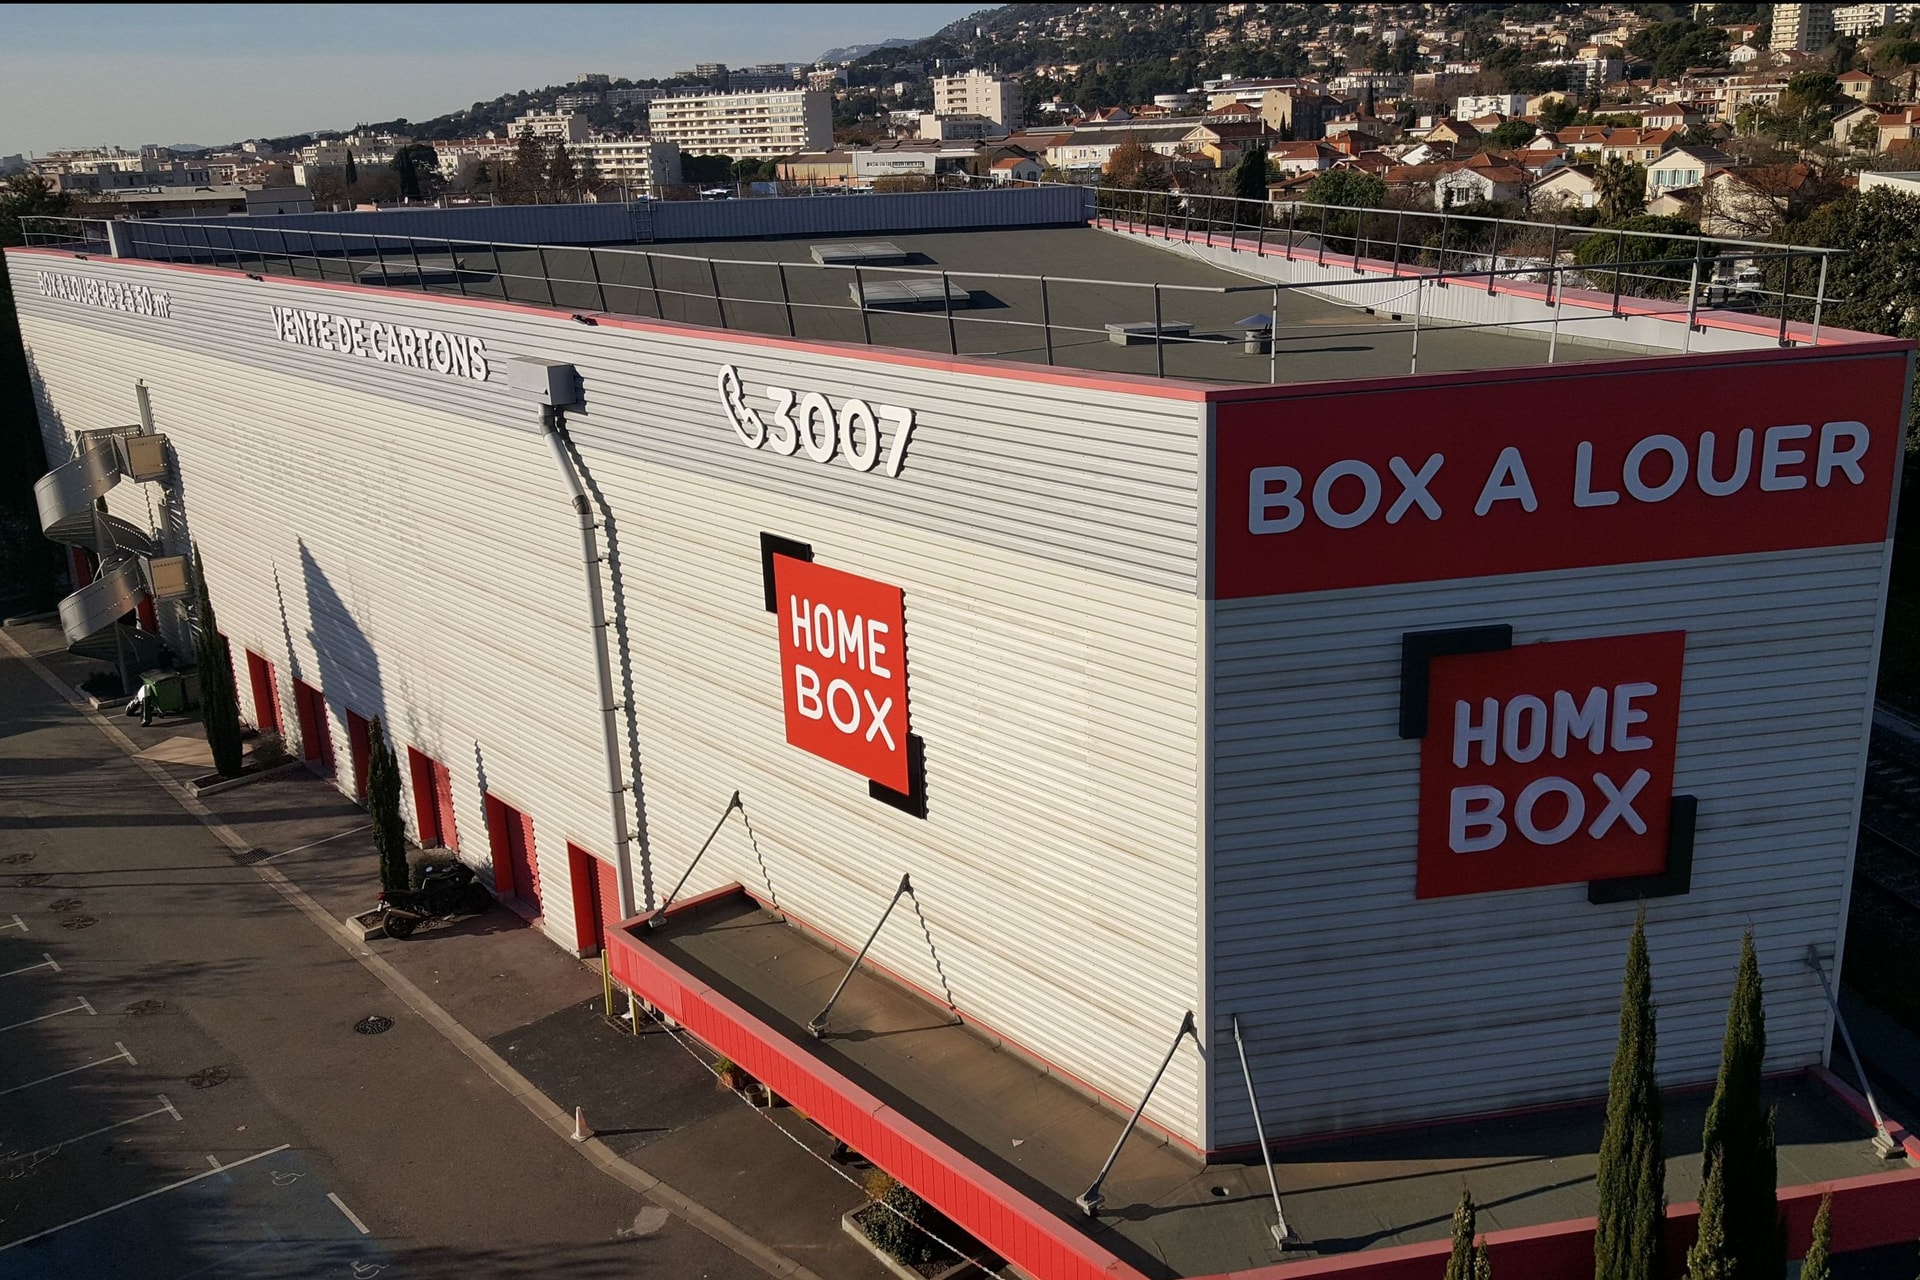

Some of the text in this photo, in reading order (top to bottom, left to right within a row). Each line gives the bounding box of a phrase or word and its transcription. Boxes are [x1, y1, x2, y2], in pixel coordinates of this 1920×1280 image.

[37, 271, 58, 298] BOX
[65, 275, 100, 306] LOUER
[100, 280, 116, 309] de
[270, 305, 488, 381] VENTE DE CARTONS
[767, 387, 913, 478] 3007
[1248, 421, 1869, 535] BOX A LOUER
[790, 594, 891, 679] HOME
[795, 664, 895, 751] BOX
[1453, 682, 1657, 768] HOME
[1449, 768, 1650, 853] BOX
